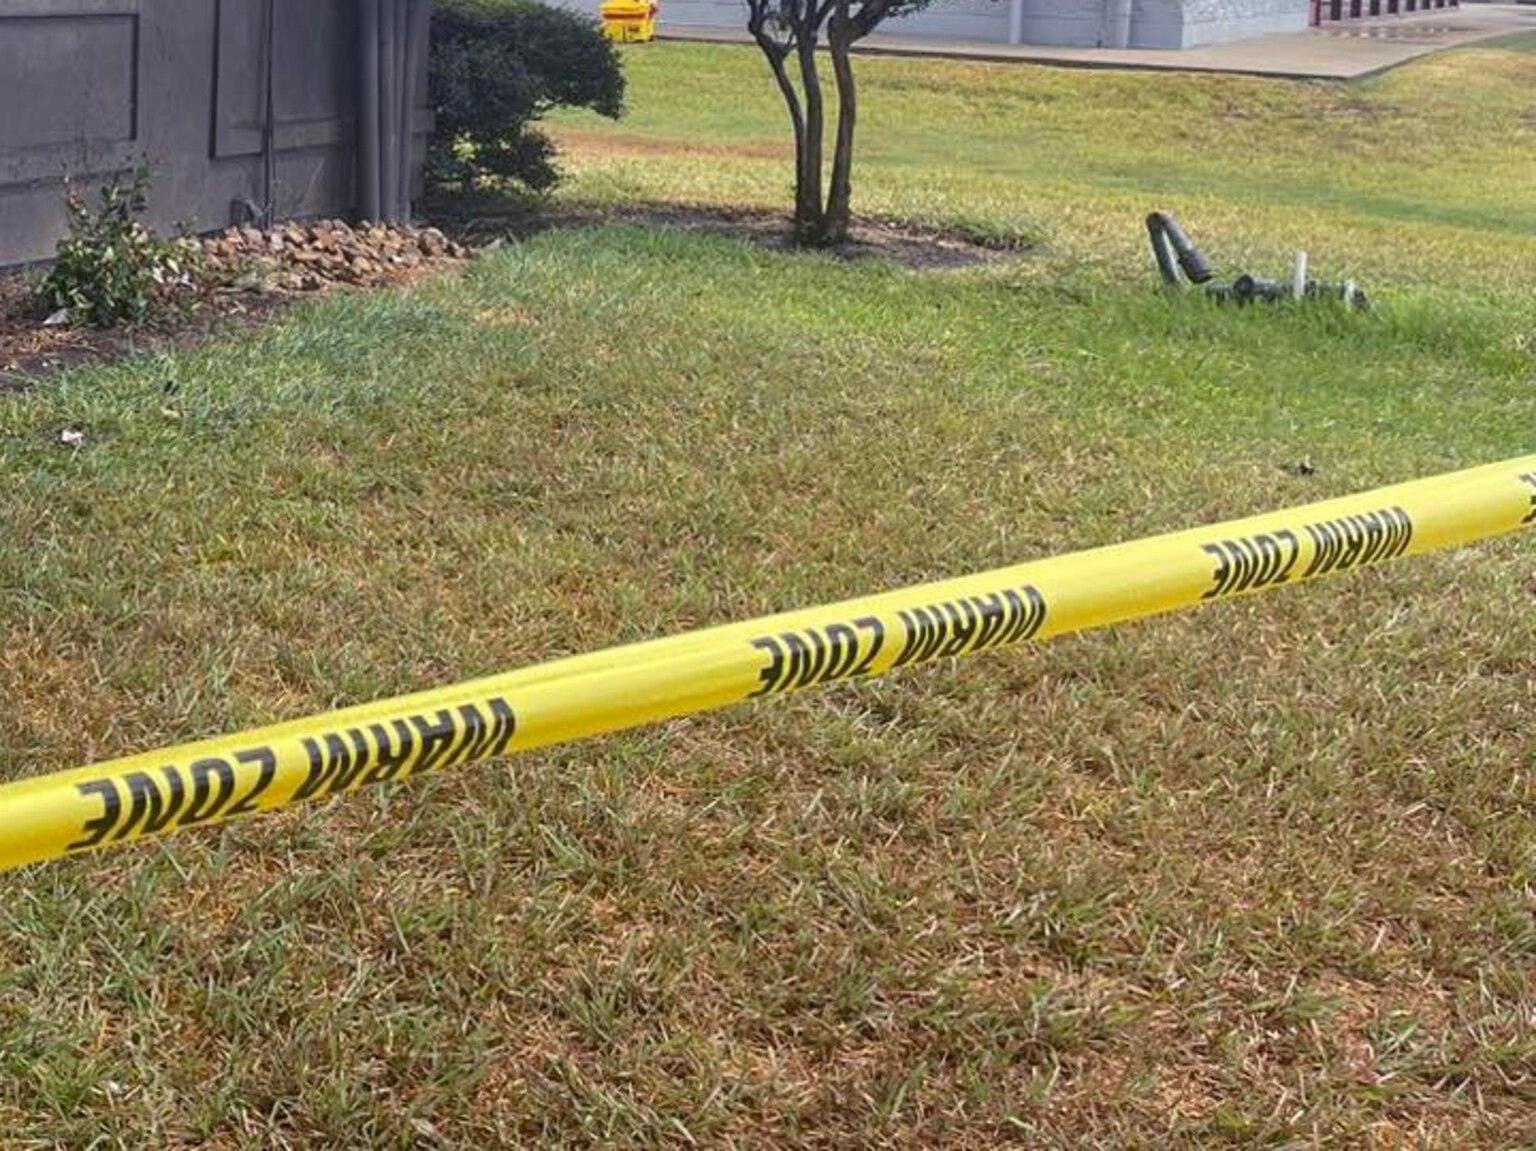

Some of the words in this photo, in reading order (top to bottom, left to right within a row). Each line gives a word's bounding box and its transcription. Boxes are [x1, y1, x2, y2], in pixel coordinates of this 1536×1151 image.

[1200, 529, 1299, 599] ZONE
[1302, 506, 1413, 578] WARM
[746, 616, 885, 698] ZONE
[890, 584, 1047, 669] WARM
[292, 697, 516, 801] WARM
[68, 746, 277, 849] ZONE
